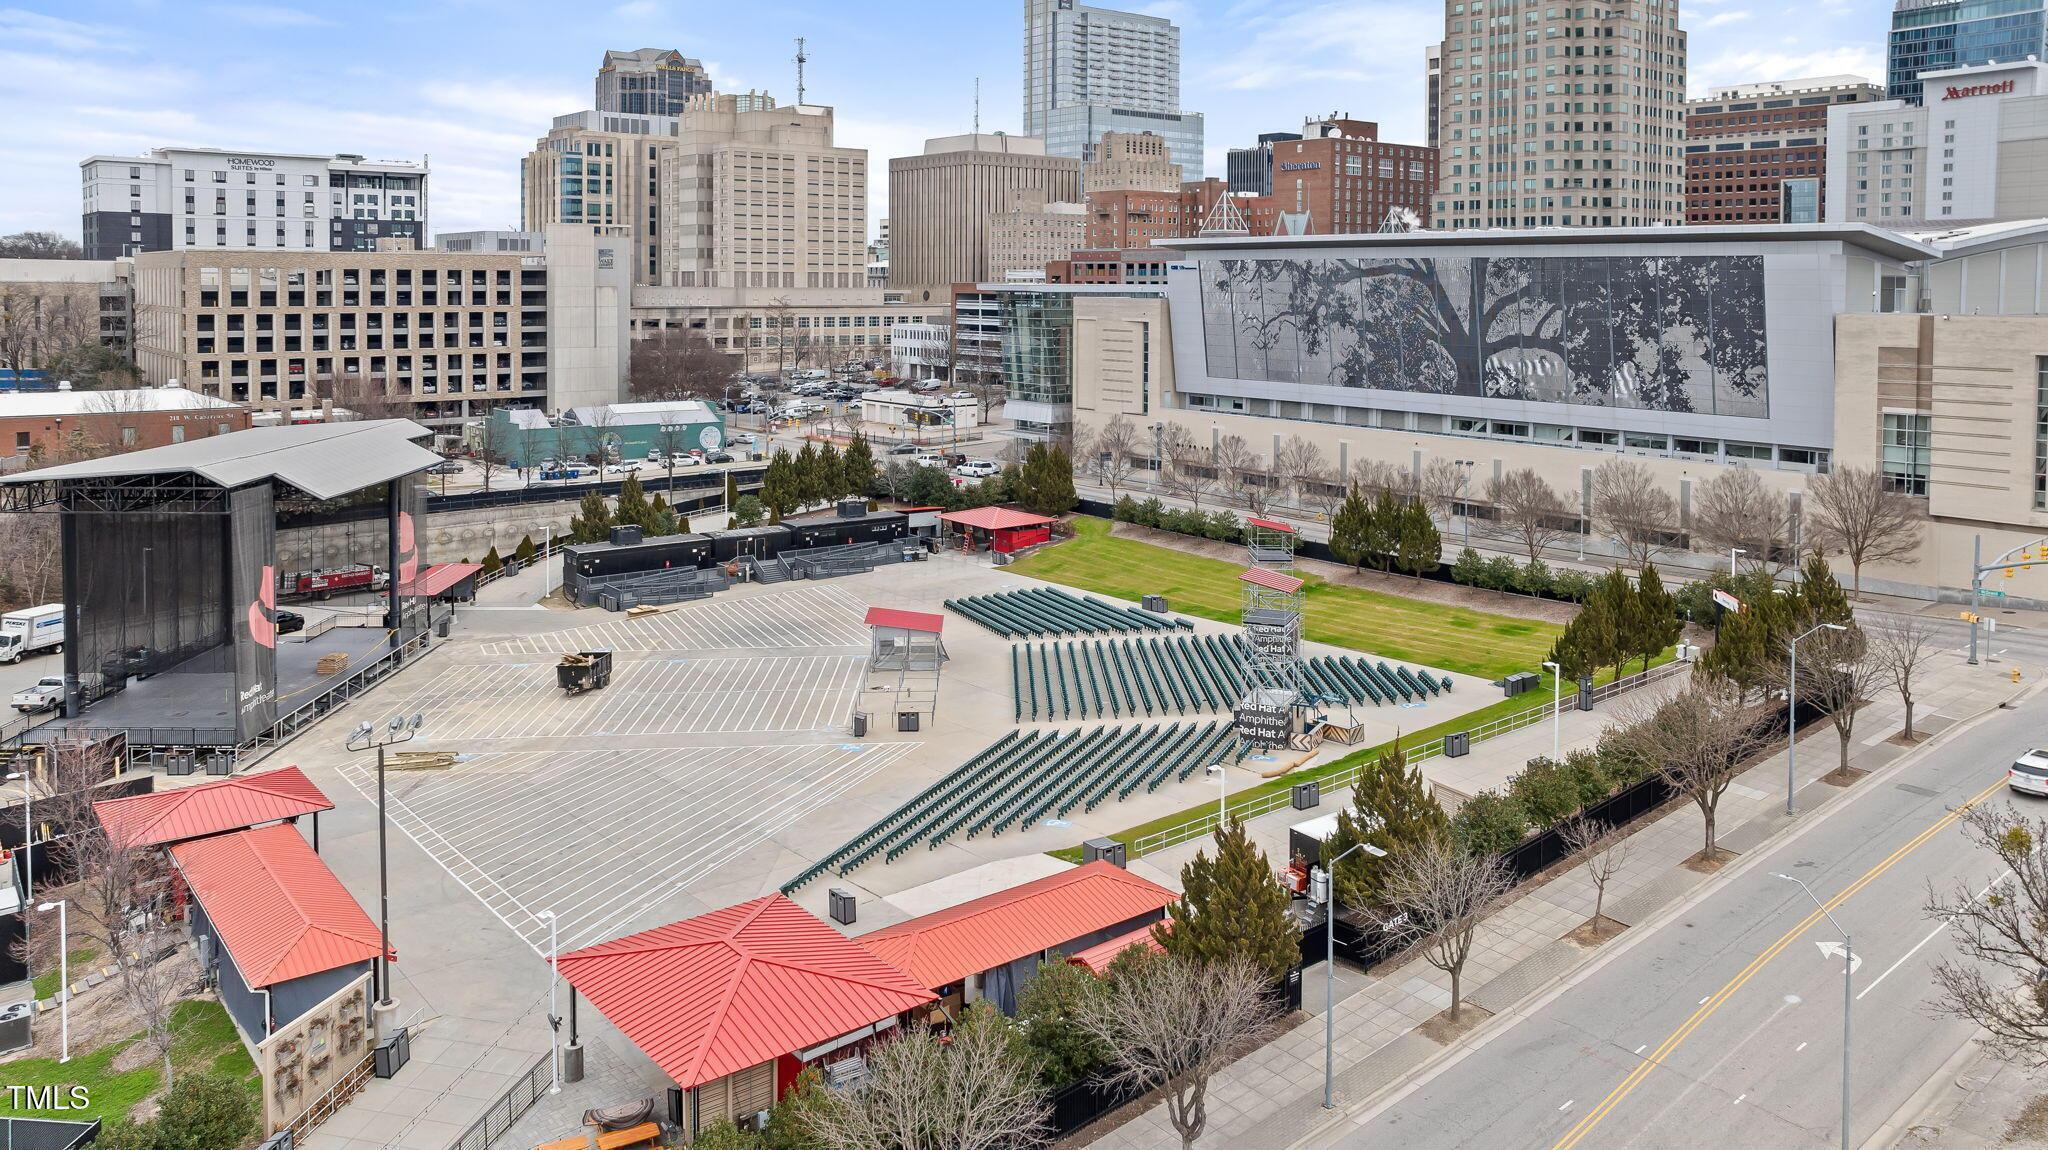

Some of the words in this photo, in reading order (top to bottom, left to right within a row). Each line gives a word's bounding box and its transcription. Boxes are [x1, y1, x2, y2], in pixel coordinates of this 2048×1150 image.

[1941, 80, 2014, 101] Marriott
[227, 158, 275, 167] HOMEWOOD
[1281, 161, 1321, 171] Sheraton
[1240, 703, 1256, 711] Red
[1259, 704, 1276, 714] Hat
[1240, 725, 1256, 736] Red
[1258, 727, 1276, 739] Hat
[1278, 730, 1285, 739] A
[1383, 915, 1403, 931] GATE
